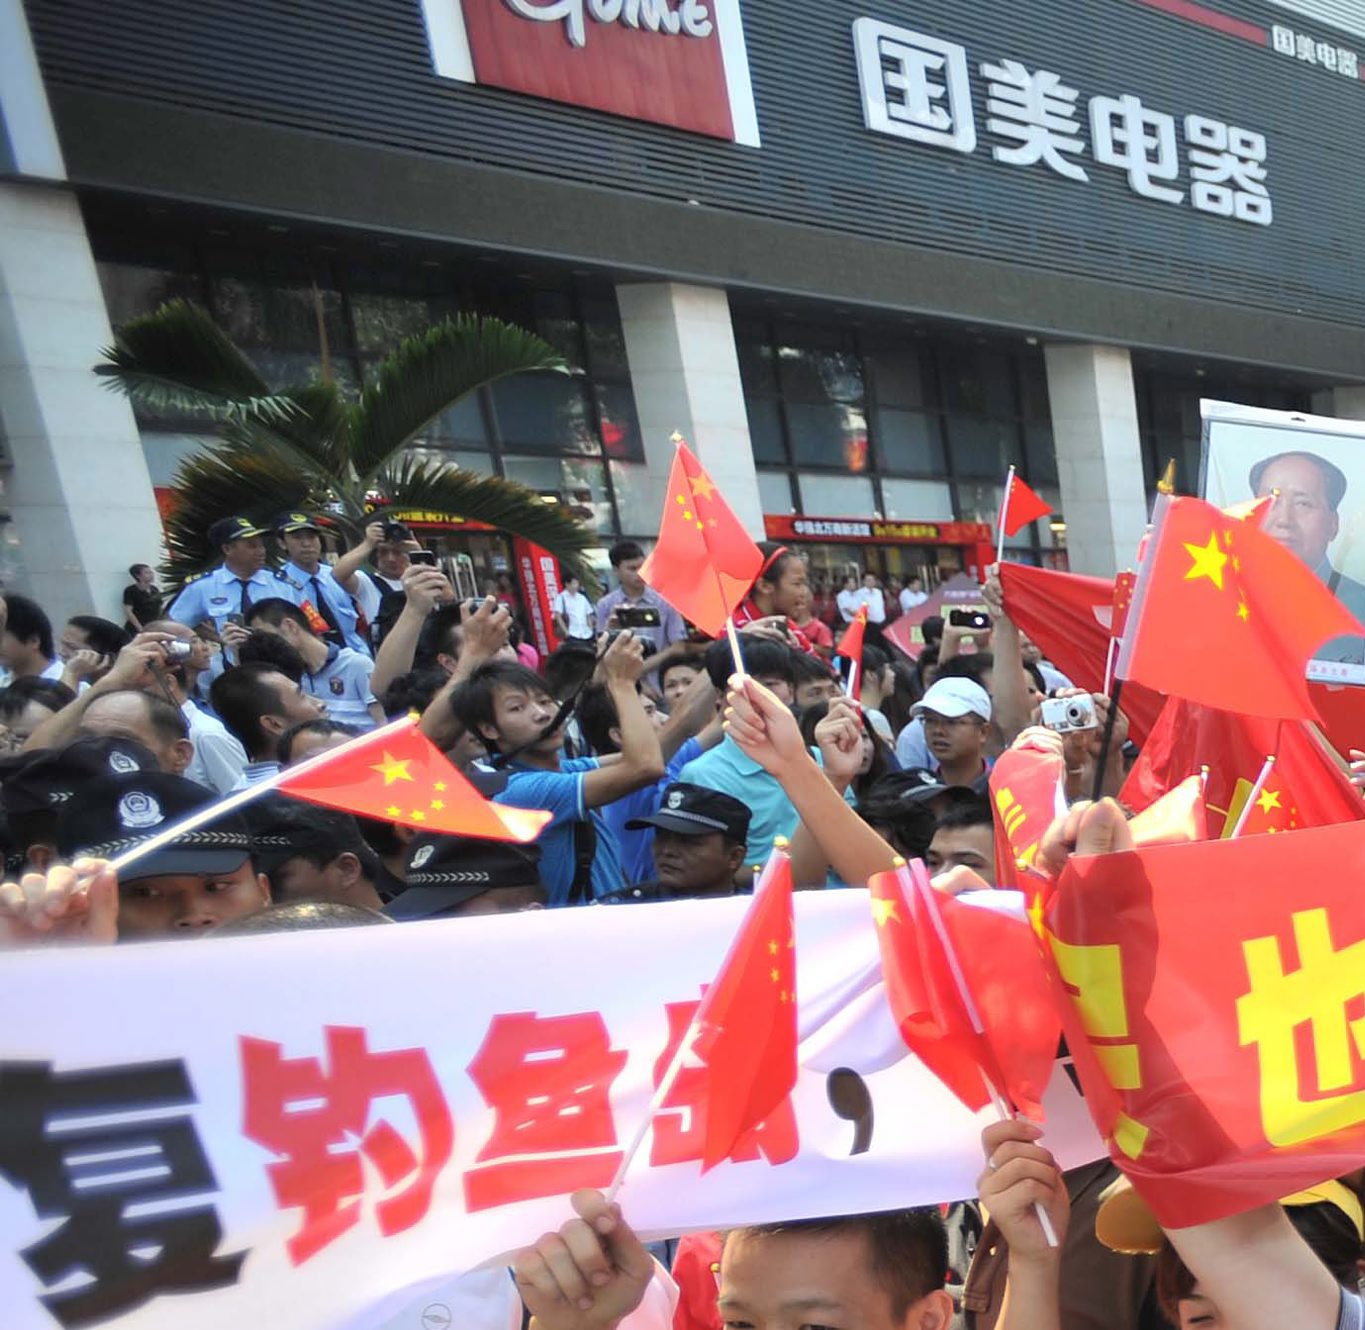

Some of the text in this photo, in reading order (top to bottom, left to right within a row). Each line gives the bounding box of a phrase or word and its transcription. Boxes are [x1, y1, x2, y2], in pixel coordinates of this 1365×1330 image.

[1272, 25, 1359, 79] 国美电器
[852, 18, 1275, 227] 国美电器
